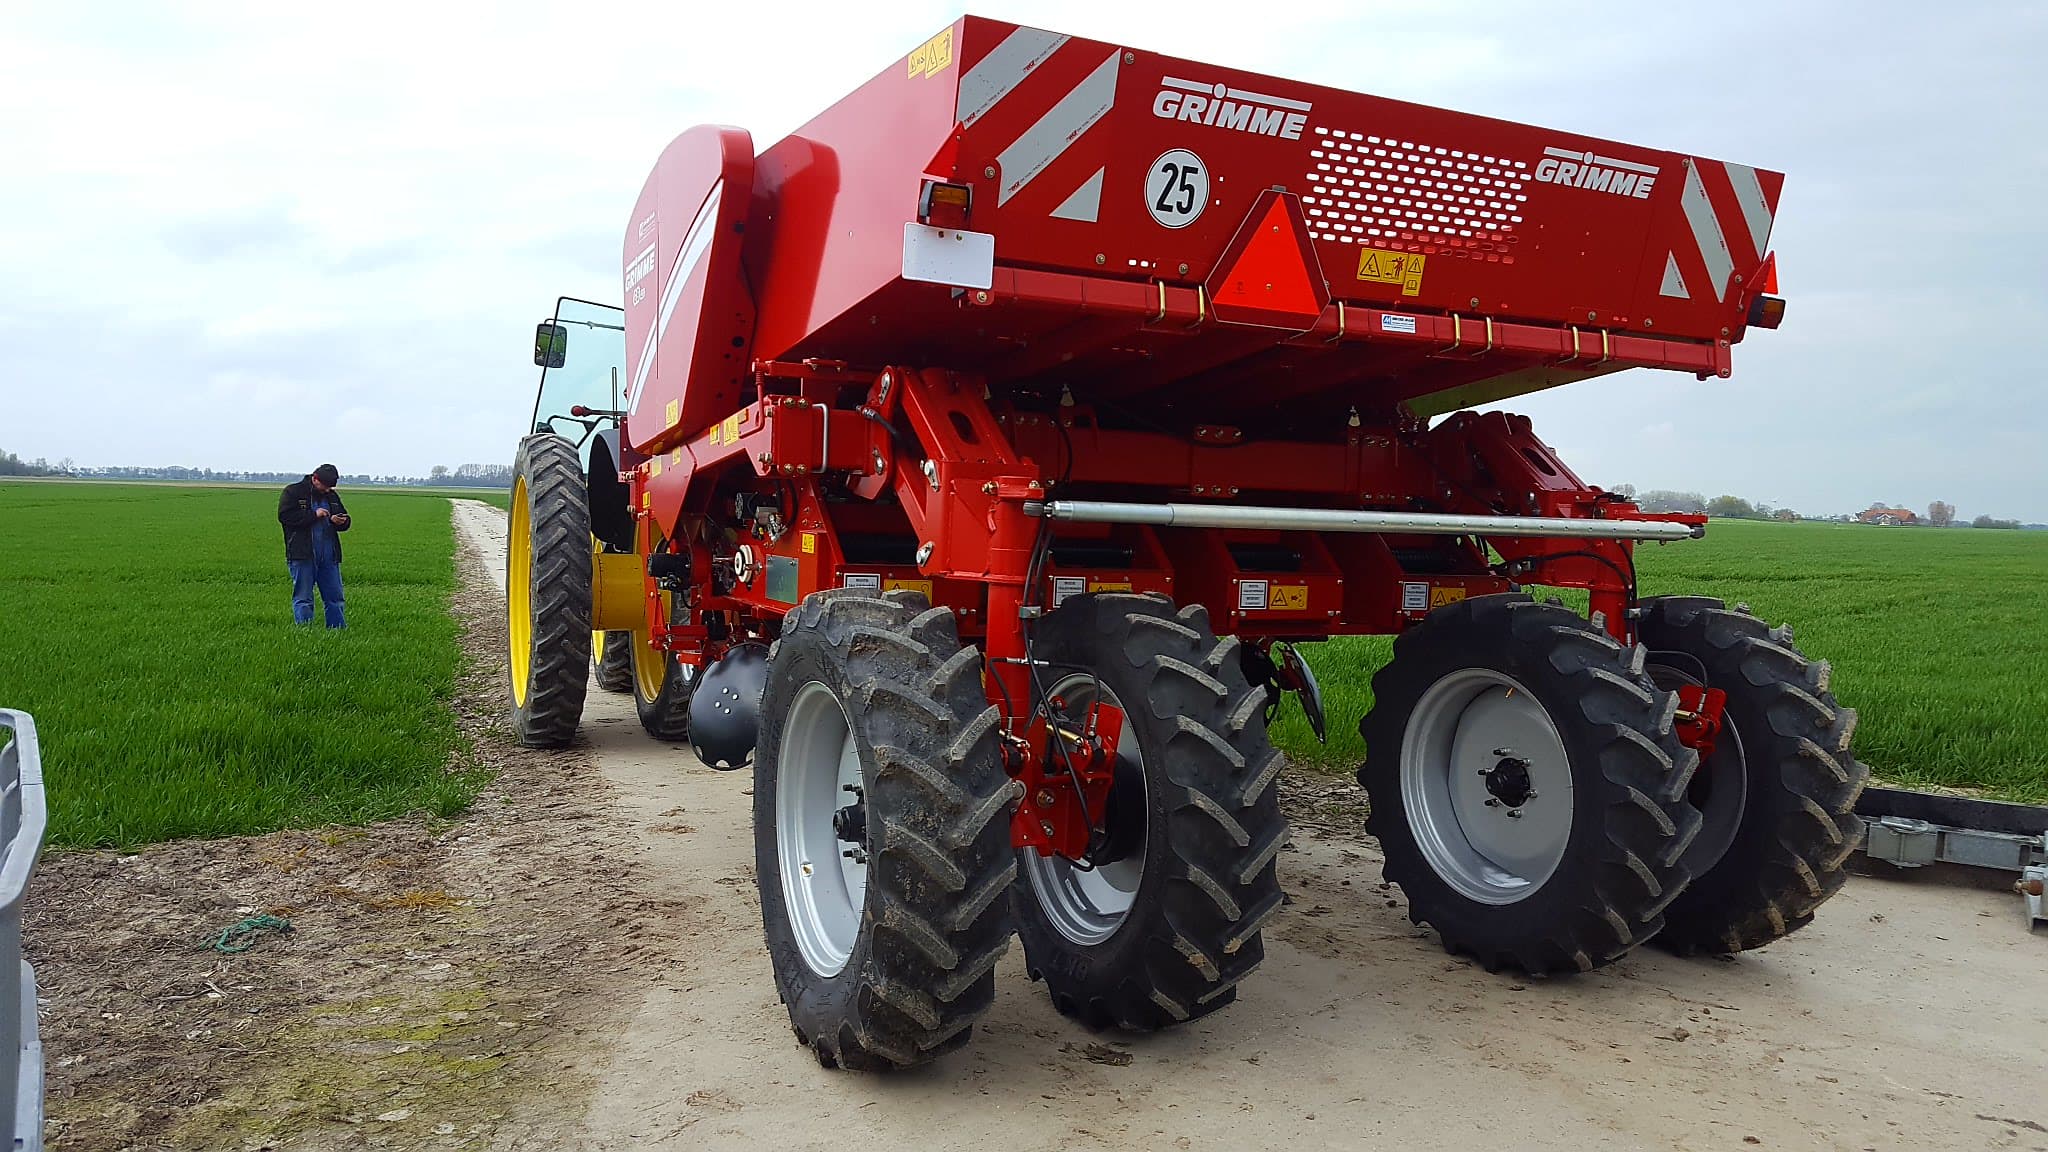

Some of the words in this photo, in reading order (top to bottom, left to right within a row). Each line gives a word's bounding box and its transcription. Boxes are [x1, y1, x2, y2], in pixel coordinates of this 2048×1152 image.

[1152, 82, 1309, 141] GRIMME
[1155, 162, 1199, 215] 25
[1534, 151, 1656, 199] GRIMME
[625, 247, 655, 293] GRIMME
